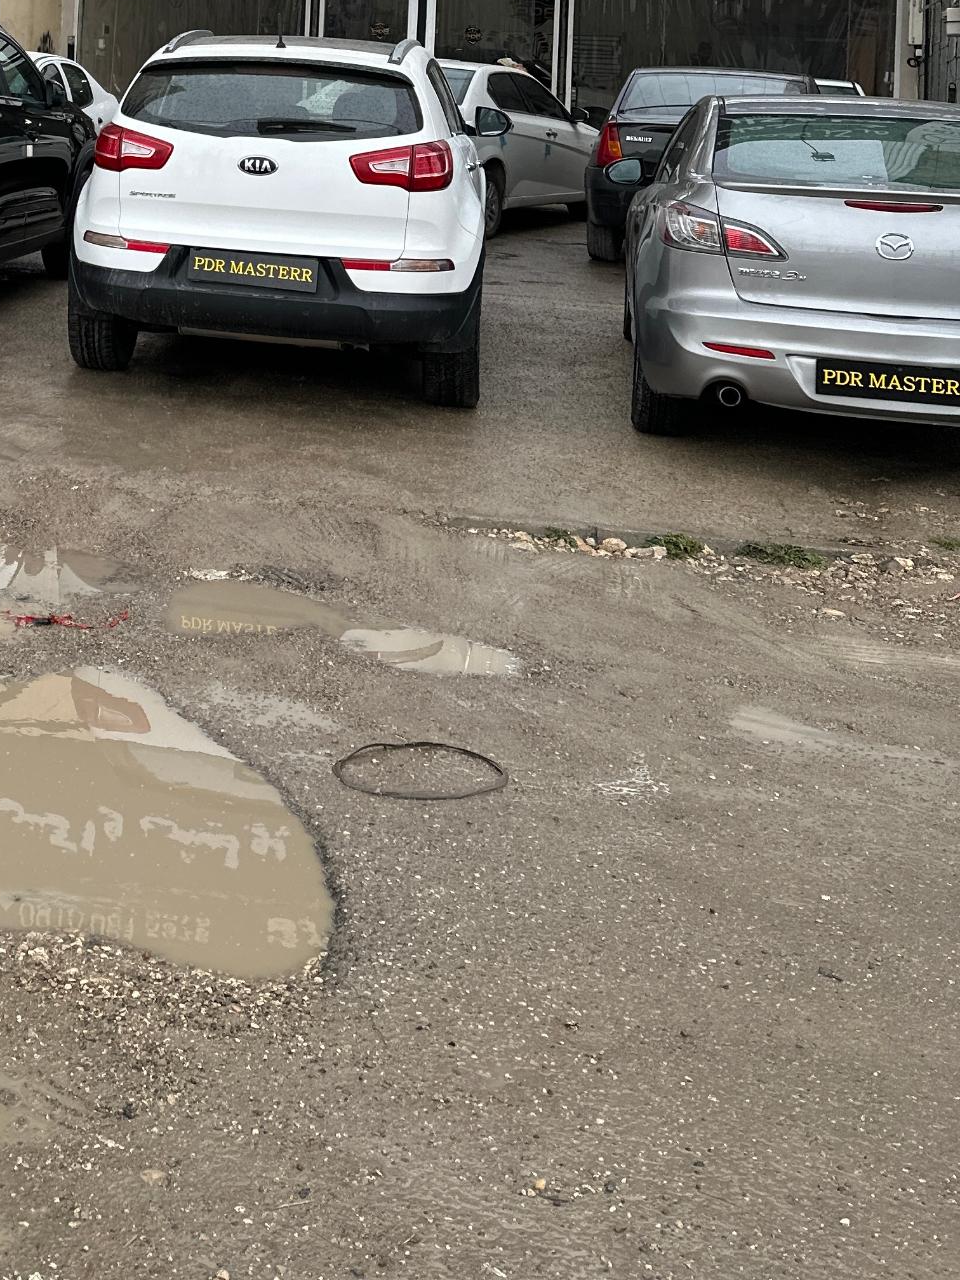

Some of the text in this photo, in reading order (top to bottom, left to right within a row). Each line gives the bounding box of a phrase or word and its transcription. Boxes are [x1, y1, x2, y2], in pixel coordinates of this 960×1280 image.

[193, 256, 313, 283] PDR MASTERR
[822, 368, 864, 388] PDR
